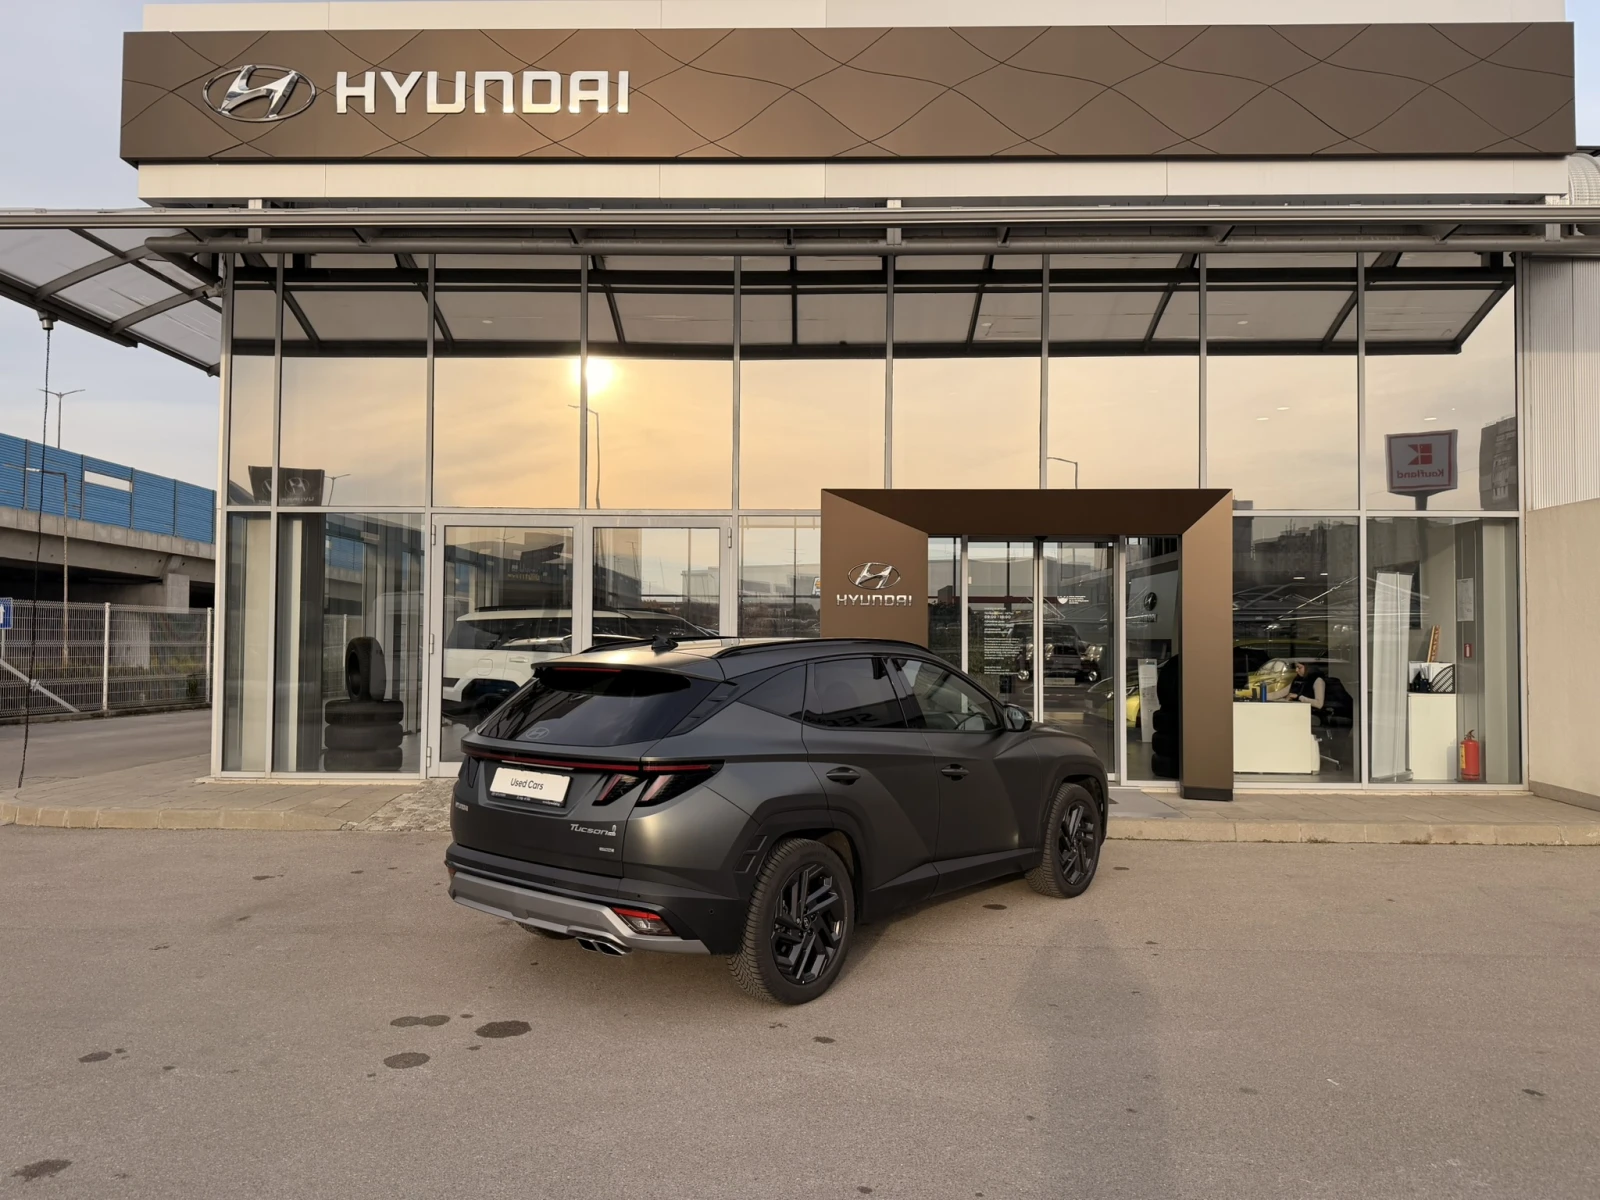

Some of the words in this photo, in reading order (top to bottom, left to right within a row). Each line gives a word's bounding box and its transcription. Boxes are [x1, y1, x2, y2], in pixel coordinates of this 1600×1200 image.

[336, 71, 629, 114] HYUNDAI
[836, 594, 912, 606] HYUNDAI
[510, 777, 527, 788] Used
[528, 780, 544, 791] Cars
